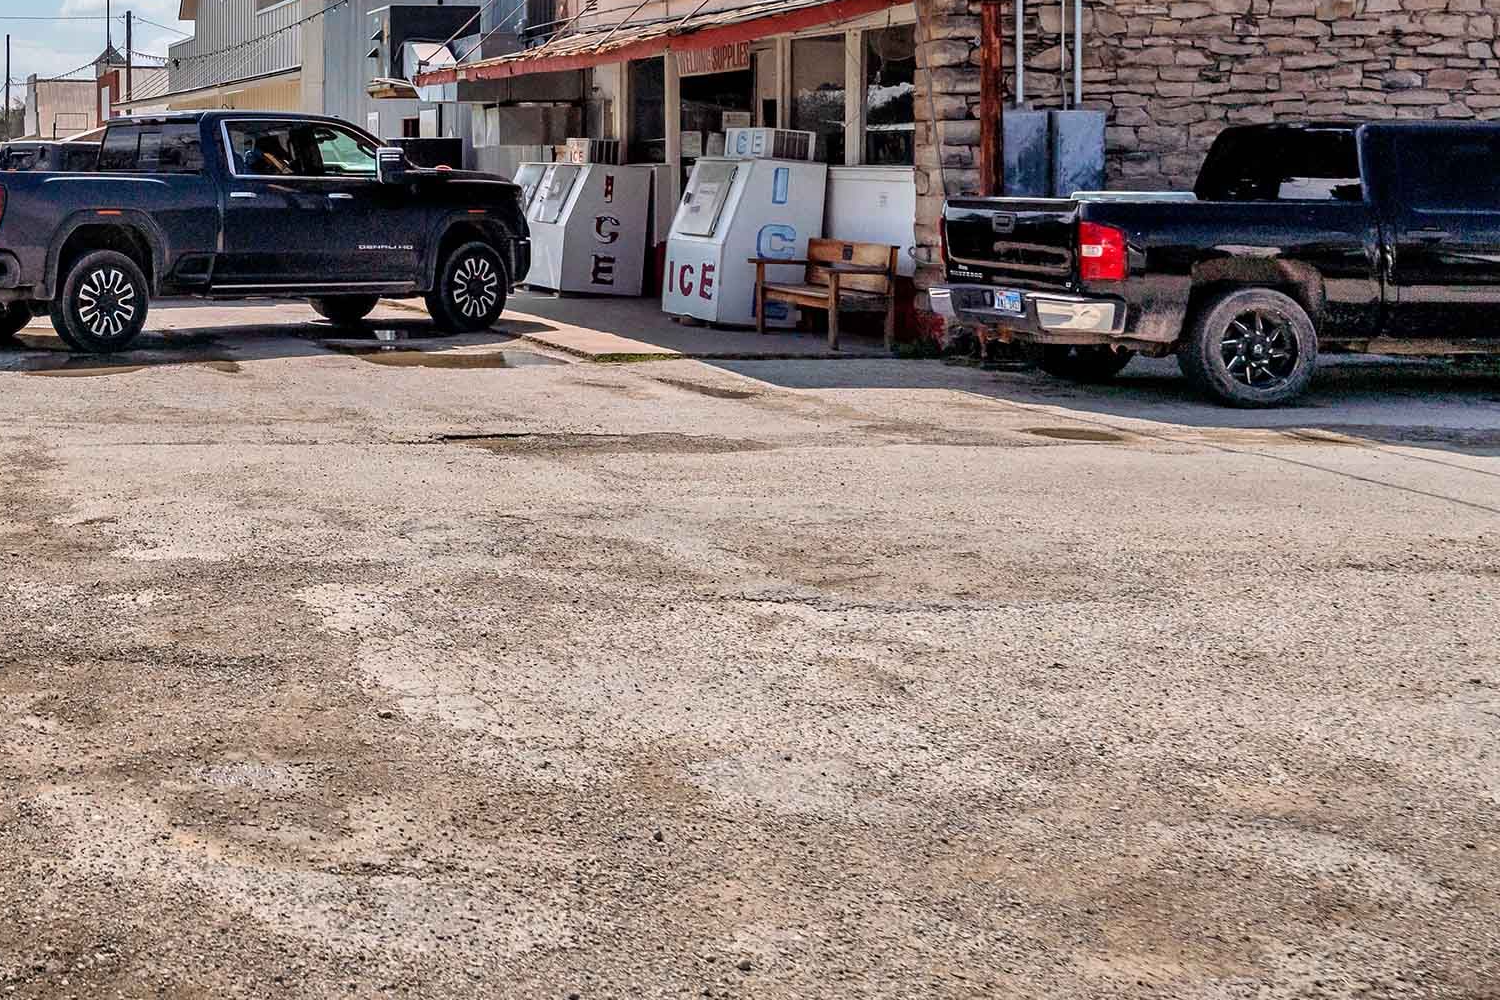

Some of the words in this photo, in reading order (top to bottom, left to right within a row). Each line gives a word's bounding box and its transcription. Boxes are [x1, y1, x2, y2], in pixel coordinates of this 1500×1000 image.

[712, 41, 749, 71] SUPPLIES
[570, 151, 584, 162] ICE
[725, 130, 763, 158] ICE
[668, 260, 716, 301] ICE
